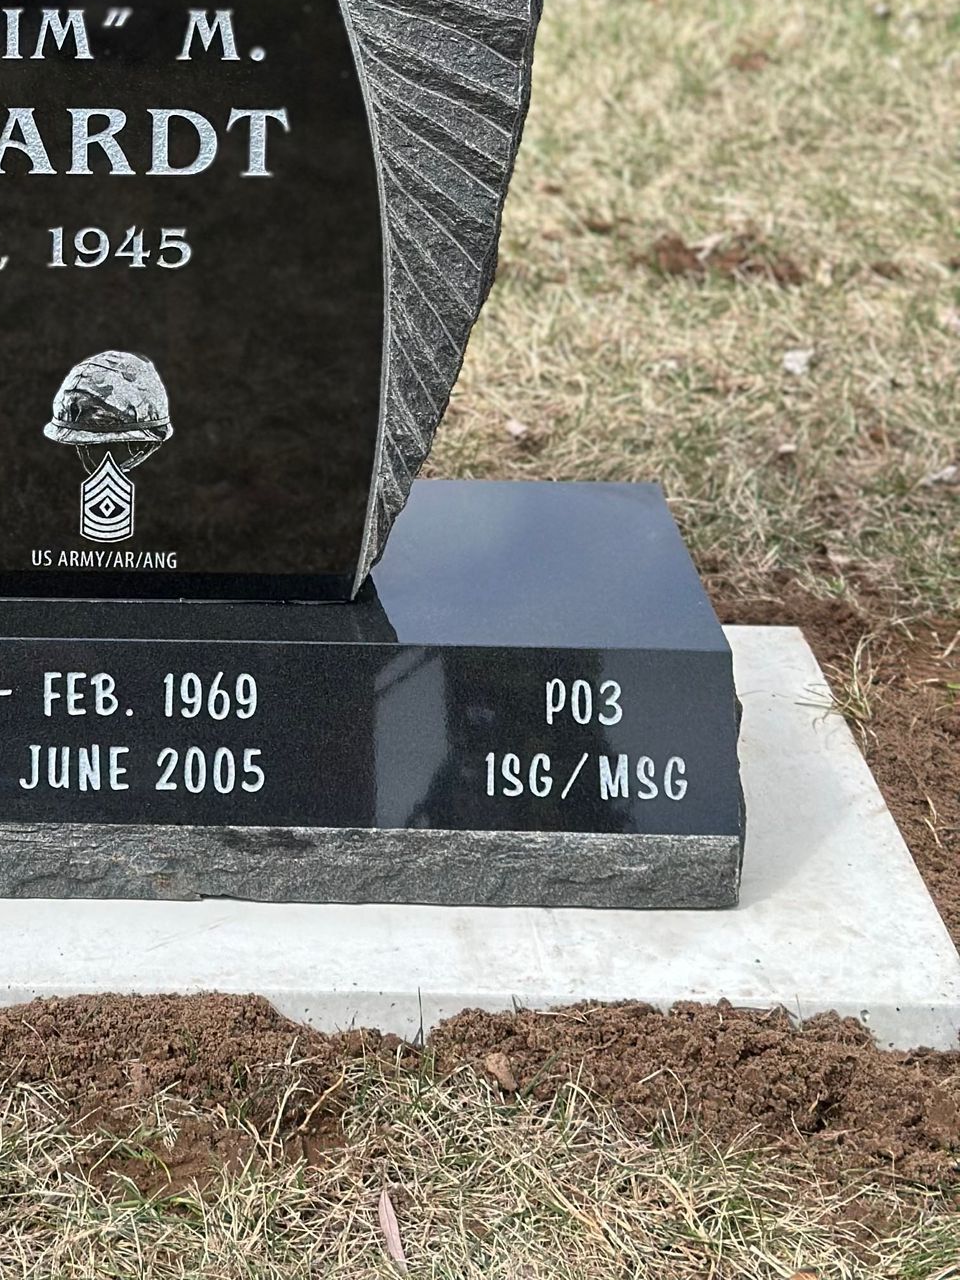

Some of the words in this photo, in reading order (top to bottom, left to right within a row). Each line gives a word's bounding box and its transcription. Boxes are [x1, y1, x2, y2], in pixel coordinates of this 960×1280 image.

[176, 9, 266, 62] M.
[48, 225, 193, 270] 1945
[30, 549, 53, 568] US
[57, 549, 178, 570] ARMY/AR/ANG
[43, 671, 135, 718] FEB.
[163, 671, 259, 721] 1969
[18, 742, 131, 793] JUNE
[155, 745, 266, 795] 2005
